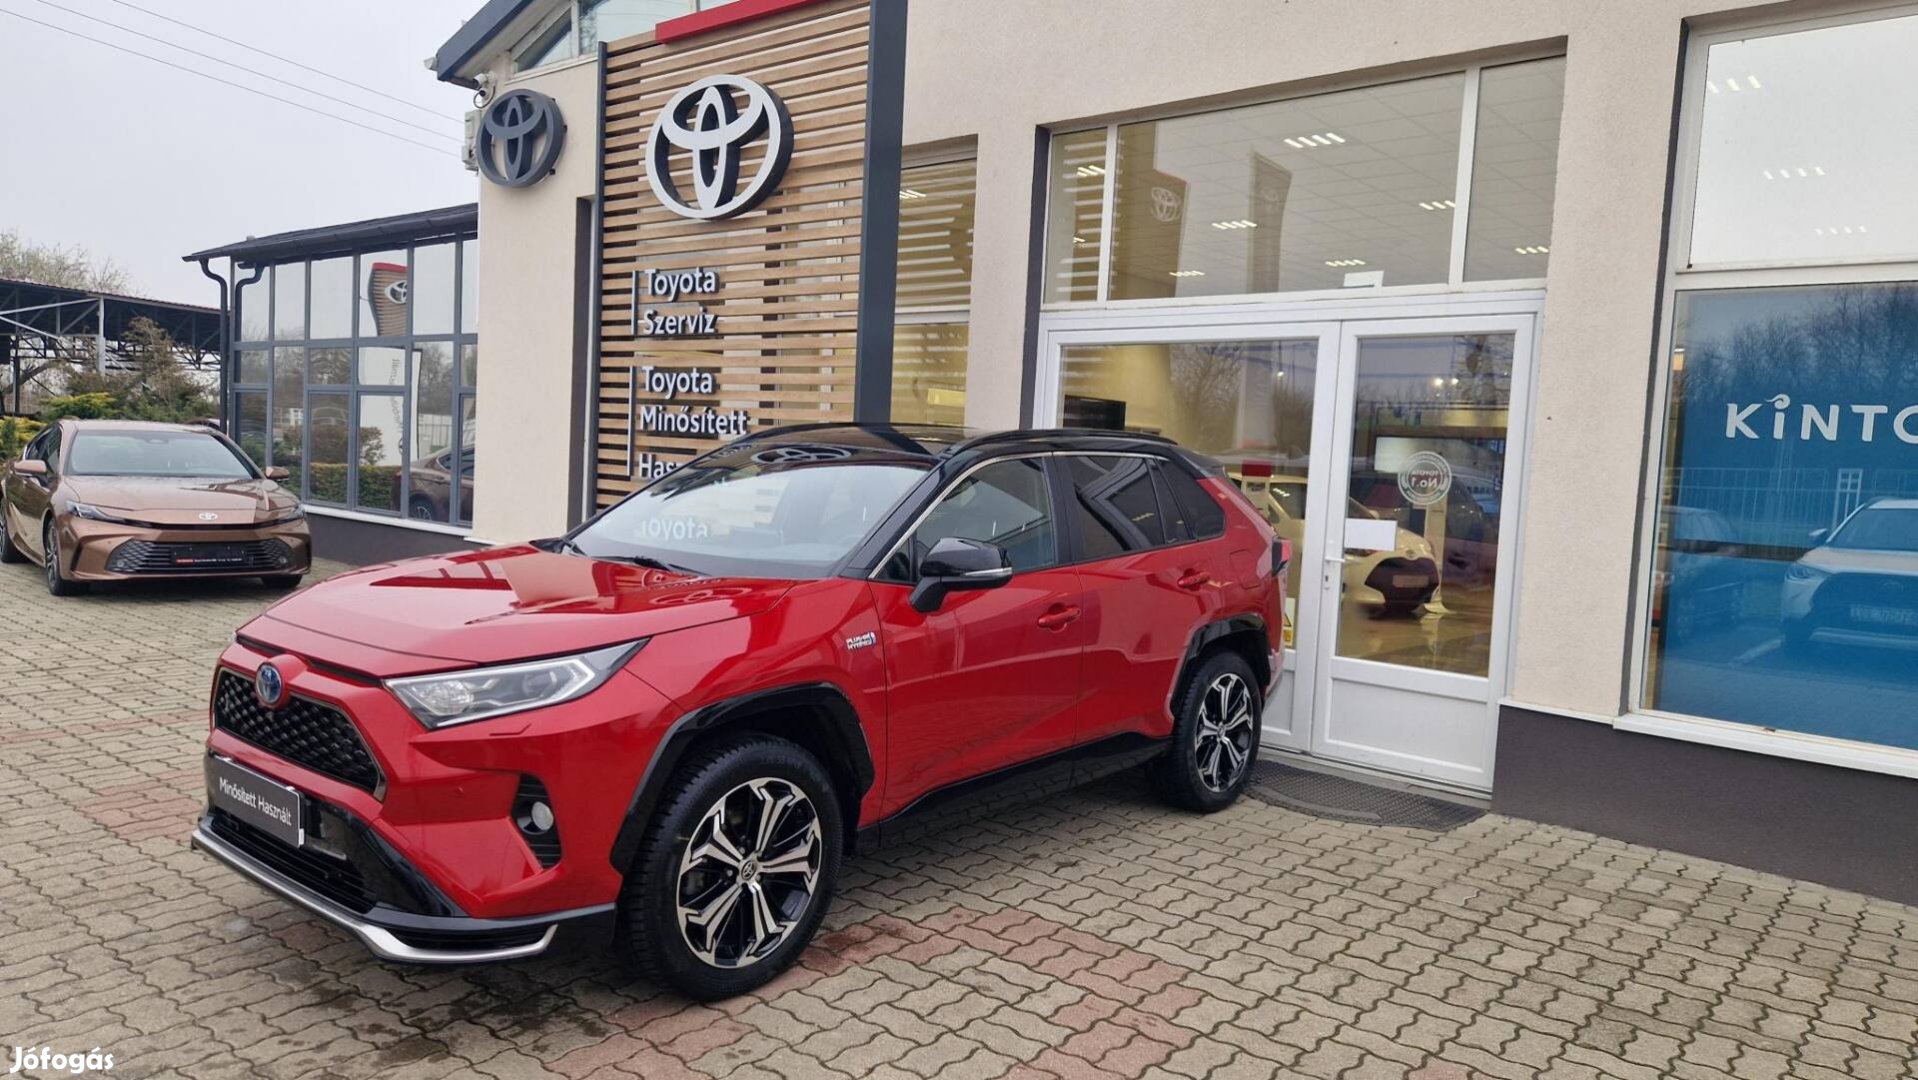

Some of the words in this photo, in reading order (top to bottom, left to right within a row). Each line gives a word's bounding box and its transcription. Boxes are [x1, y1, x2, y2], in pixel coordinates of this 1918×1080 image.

[644, 266, 717, 302] Toyota
[643, 306, 716, 335] Szerviz
[641, 366, 714, 400] Toyota
[640, 405, 748, 435] Minősített
[639, 453, 684, 479] Has
[258, 795, 292, 826] Használt
